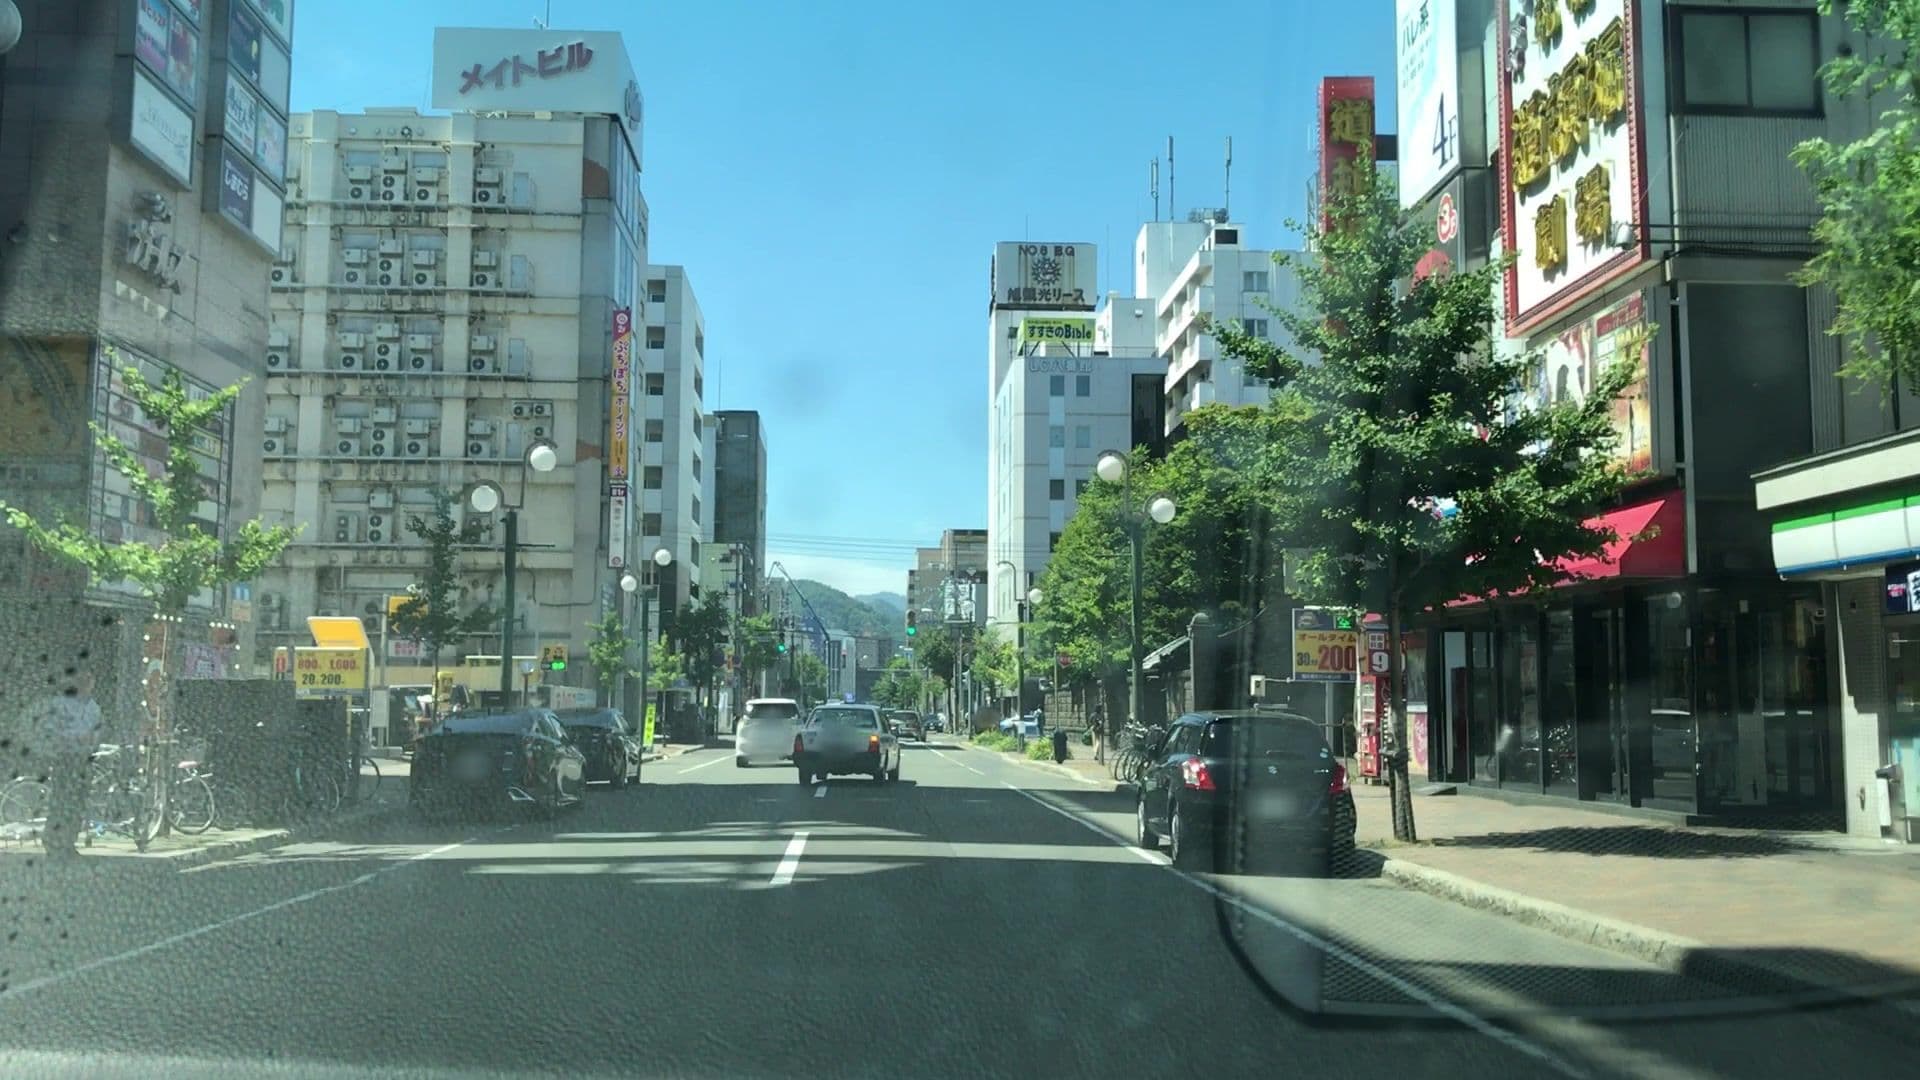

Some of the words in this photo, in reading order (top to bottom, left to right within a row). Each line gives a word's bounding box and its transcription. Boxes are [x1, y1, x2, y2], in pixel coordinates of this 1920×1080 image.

[459, 41, 593, 94] メイトビル
[1027, 324, 1092, 339] すすきのBible
[1297, 633, 1356, 642] オールタイム
